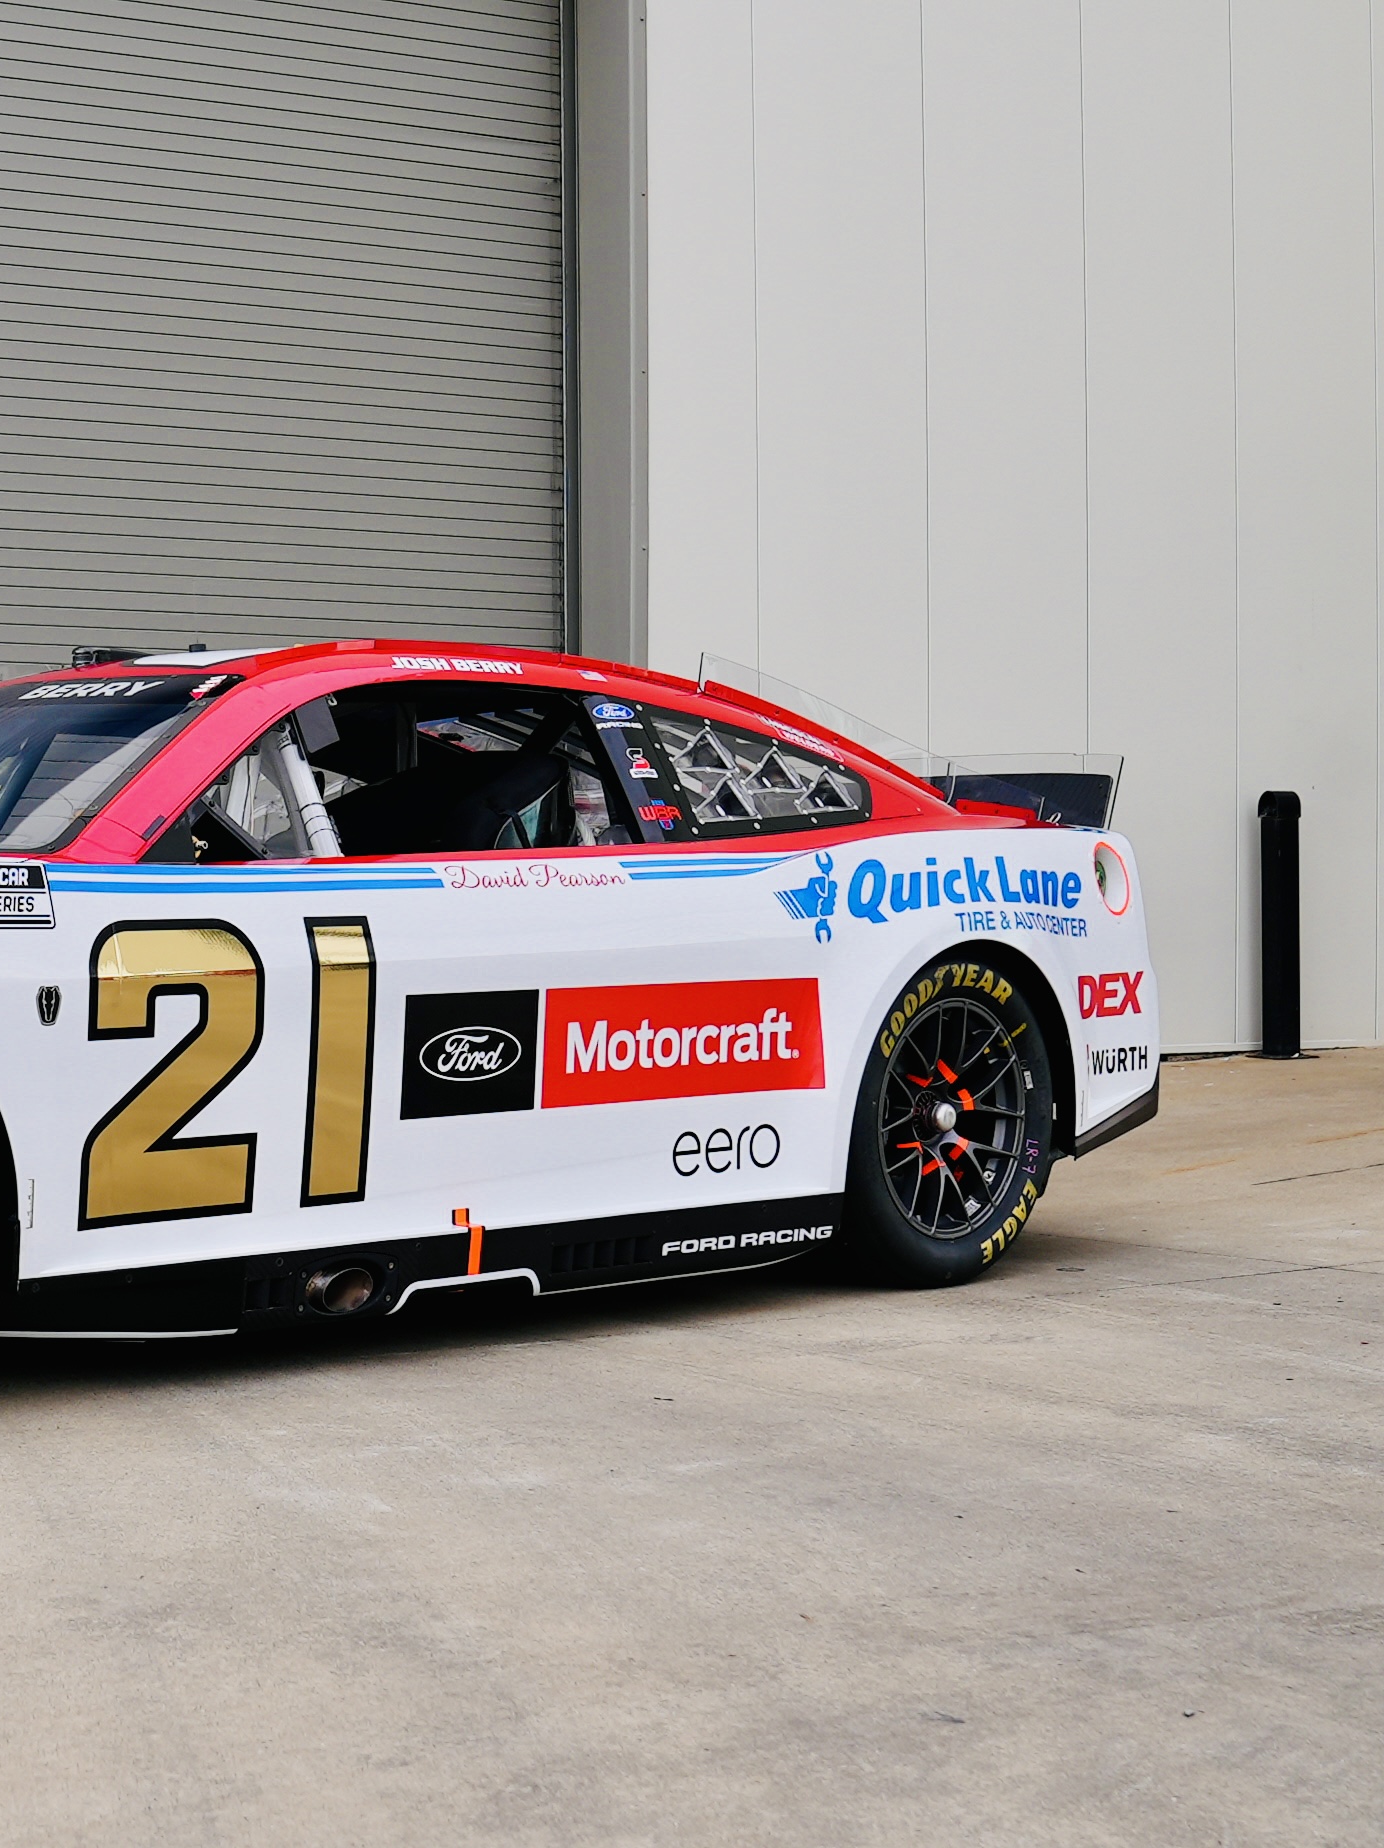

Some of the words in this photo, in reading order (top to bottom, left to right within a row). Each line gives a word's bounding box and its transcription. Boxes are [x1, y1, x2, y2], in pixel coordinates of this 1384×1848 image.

[391, 656, 451, 671] JOSH
[451, 658, 524, 675] BERRY
[18, 680, 165, 700] BERRY
[444, 865, 528, 889] David
[528, 863, 626, 887] Pearson
[954, 911, 996, 932] TIRE
[1000, 911, 1011, 930] &
[878, 961, 1015, 1060] GOODYEAR
[1077, 970, 1144, 1019] DEX
[437, 1033, 505, 1073] Ford
[77, 916, 377, 1231] 21
[672, 1123, 781, 1177] eero
[661, 1235, 736, 1257] FORD
[739, 1225, 834, 1248] RACING
[980, 1178, 1039, 1265] EAGLE
